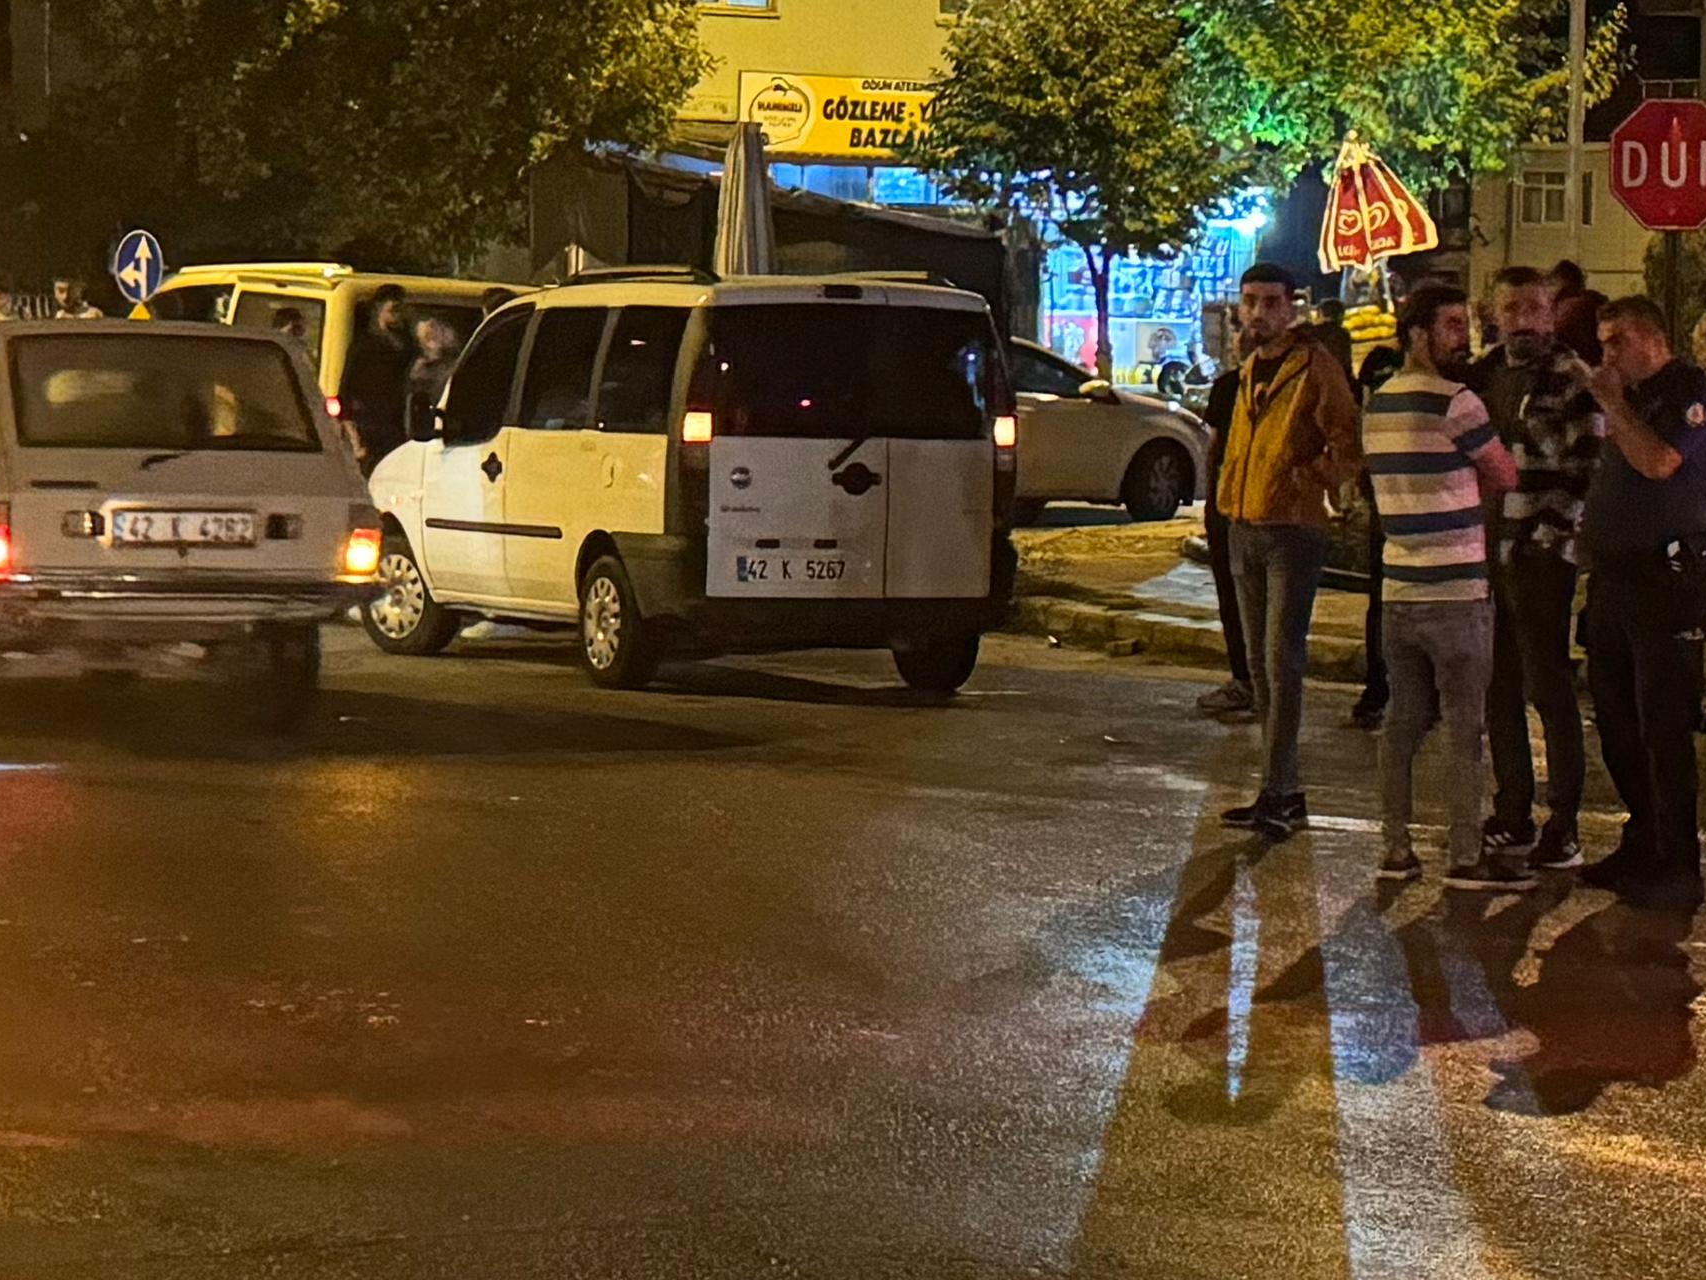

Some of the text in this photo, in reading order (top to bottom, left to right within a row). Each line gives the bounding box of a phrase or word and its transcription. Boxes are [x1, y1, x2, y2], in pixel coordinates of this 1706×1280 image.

[823, 96, 906, 122] GÖZLEME
[748, 560, 846, 580] 42 K 5267
